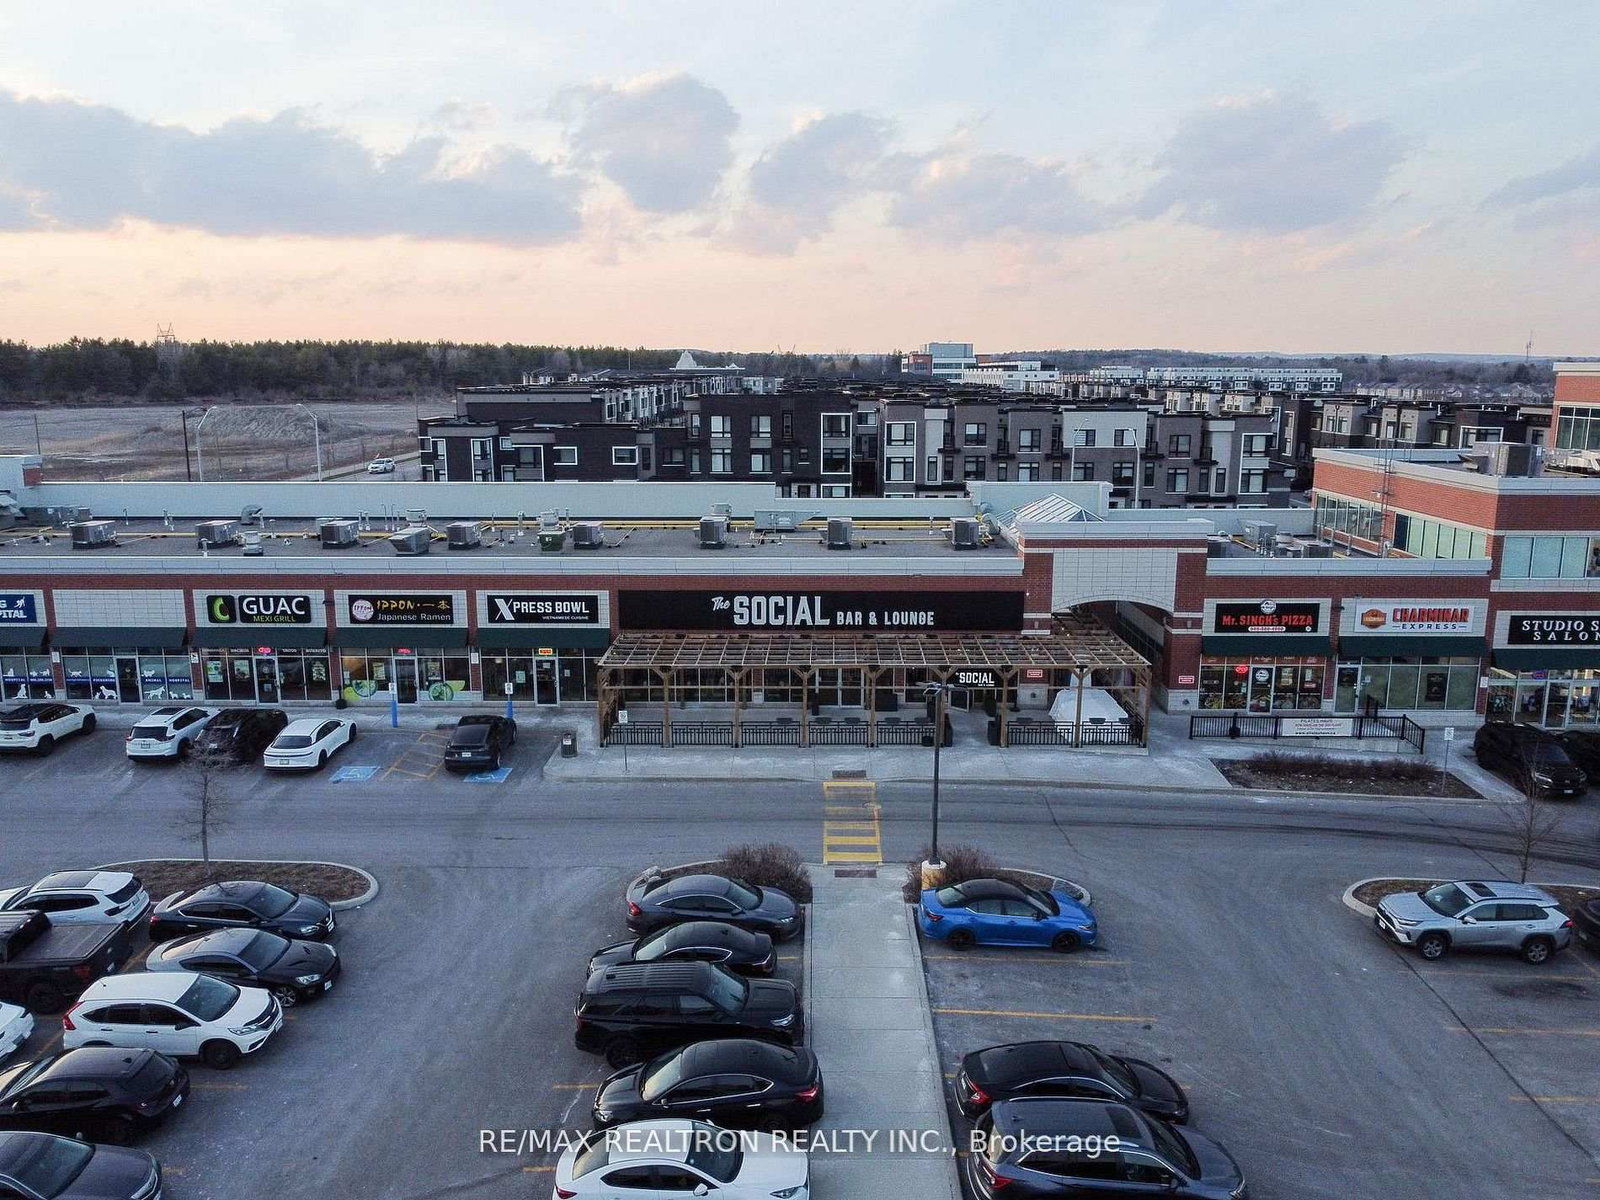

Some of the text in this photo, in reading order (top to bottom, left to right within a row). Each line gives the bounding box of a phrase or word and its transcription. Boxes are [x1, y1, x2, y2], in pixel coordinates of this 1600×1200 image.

[242, 597, 306, 615] GUAC
[376, 599, 415, 611] IPPON
[494, 598, 590, 621] XPRESS BOWL
[711, 595, 935, 626] The SOCIAL BAR & LOUNGE
[253, 615, 297, 623] MEXI GRILL
[376, 612, 451, 622] Japanese Ramen
[1222, 615, 1238, 626] Mr.
[1281, 615, 1313, 625] PIZZA
[1392, 607, 1470, 623] CHARMINAR
[1522, 620, 1584, 631] STUDIO
[959, 672, 995, 684] SOCIAL
